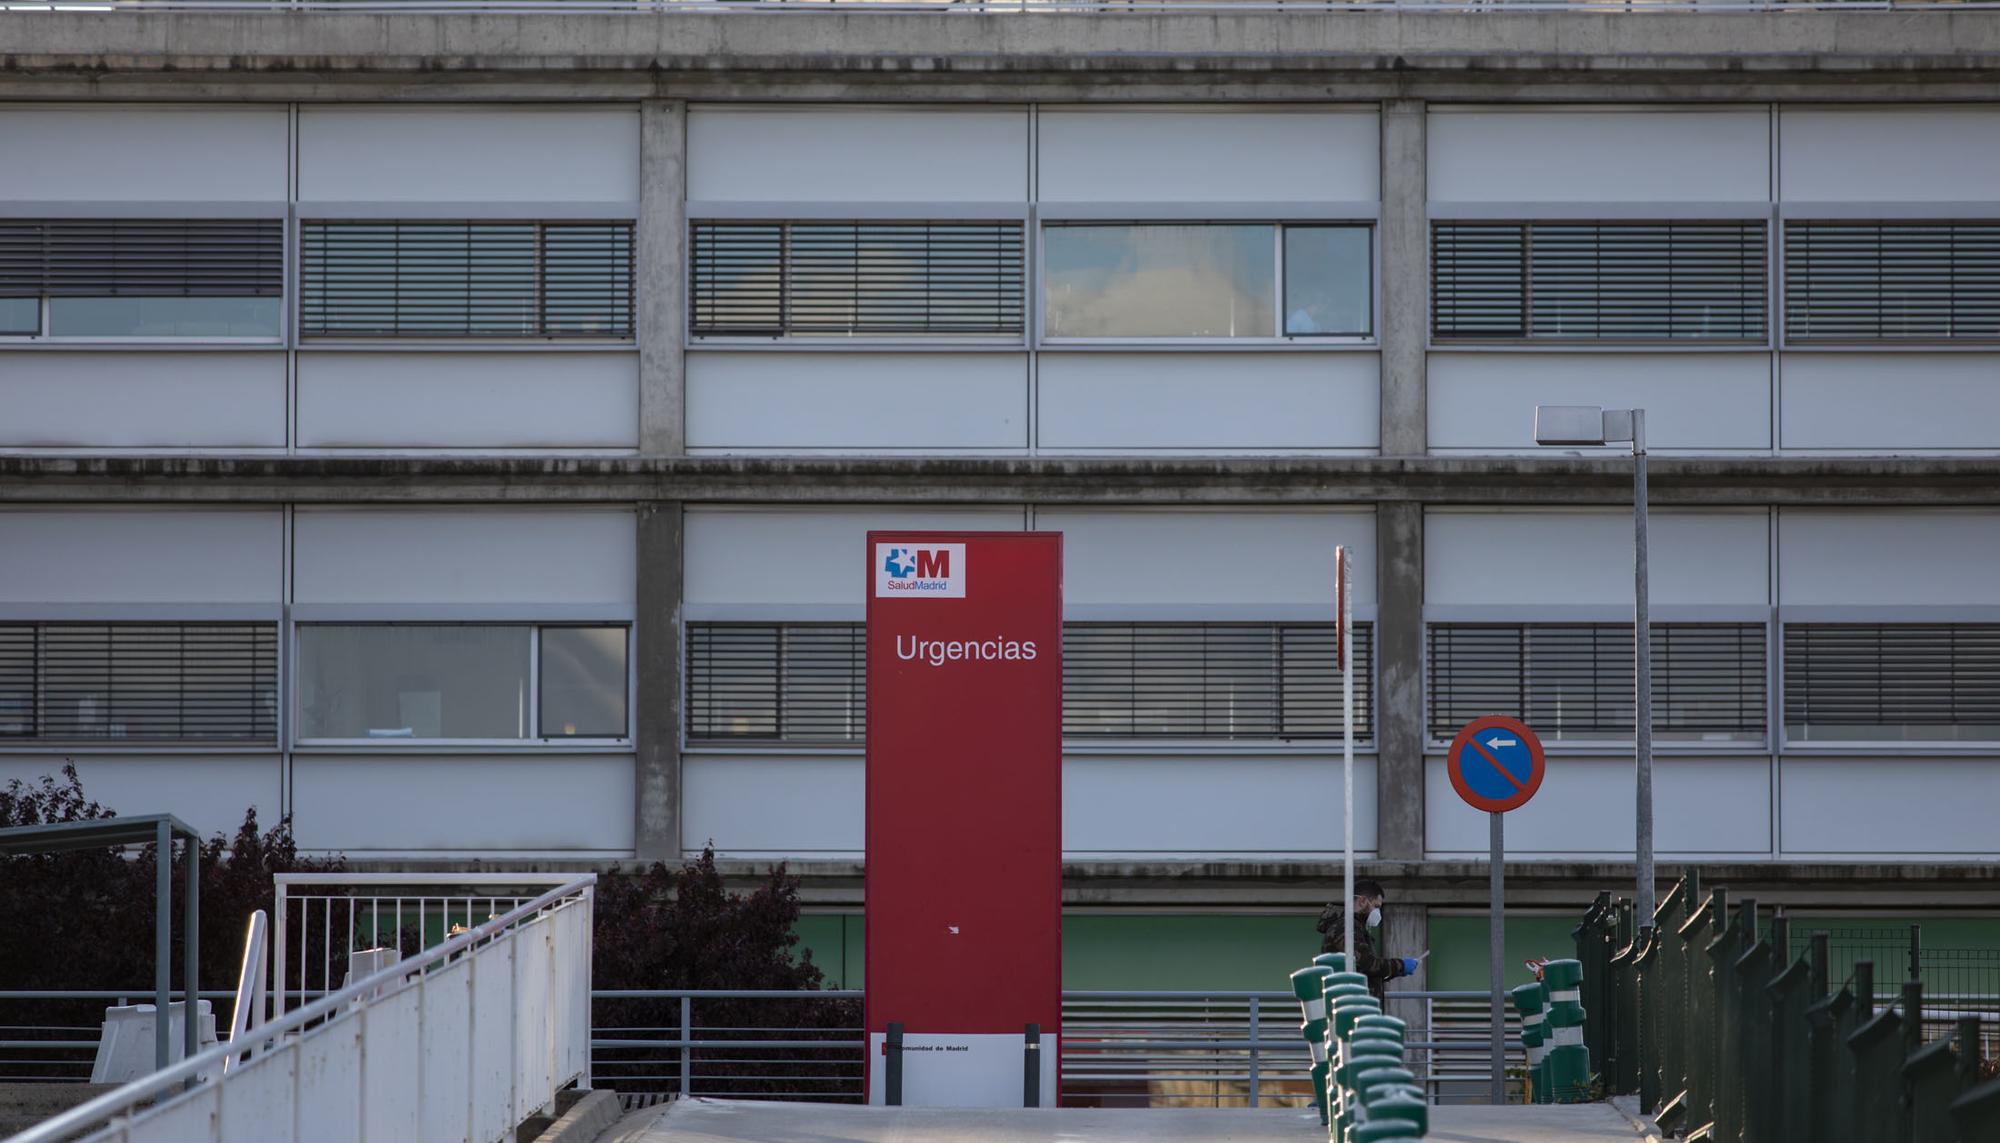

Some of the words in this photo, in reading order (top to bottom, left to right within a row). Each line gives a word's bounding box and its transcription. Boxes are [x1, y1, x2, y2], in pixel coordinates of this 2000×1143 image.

[916, 550, 950, 578] M
[887, 580, 947, 590] SaludMadrid
[896, 635, 1037, 666] Urgencias
